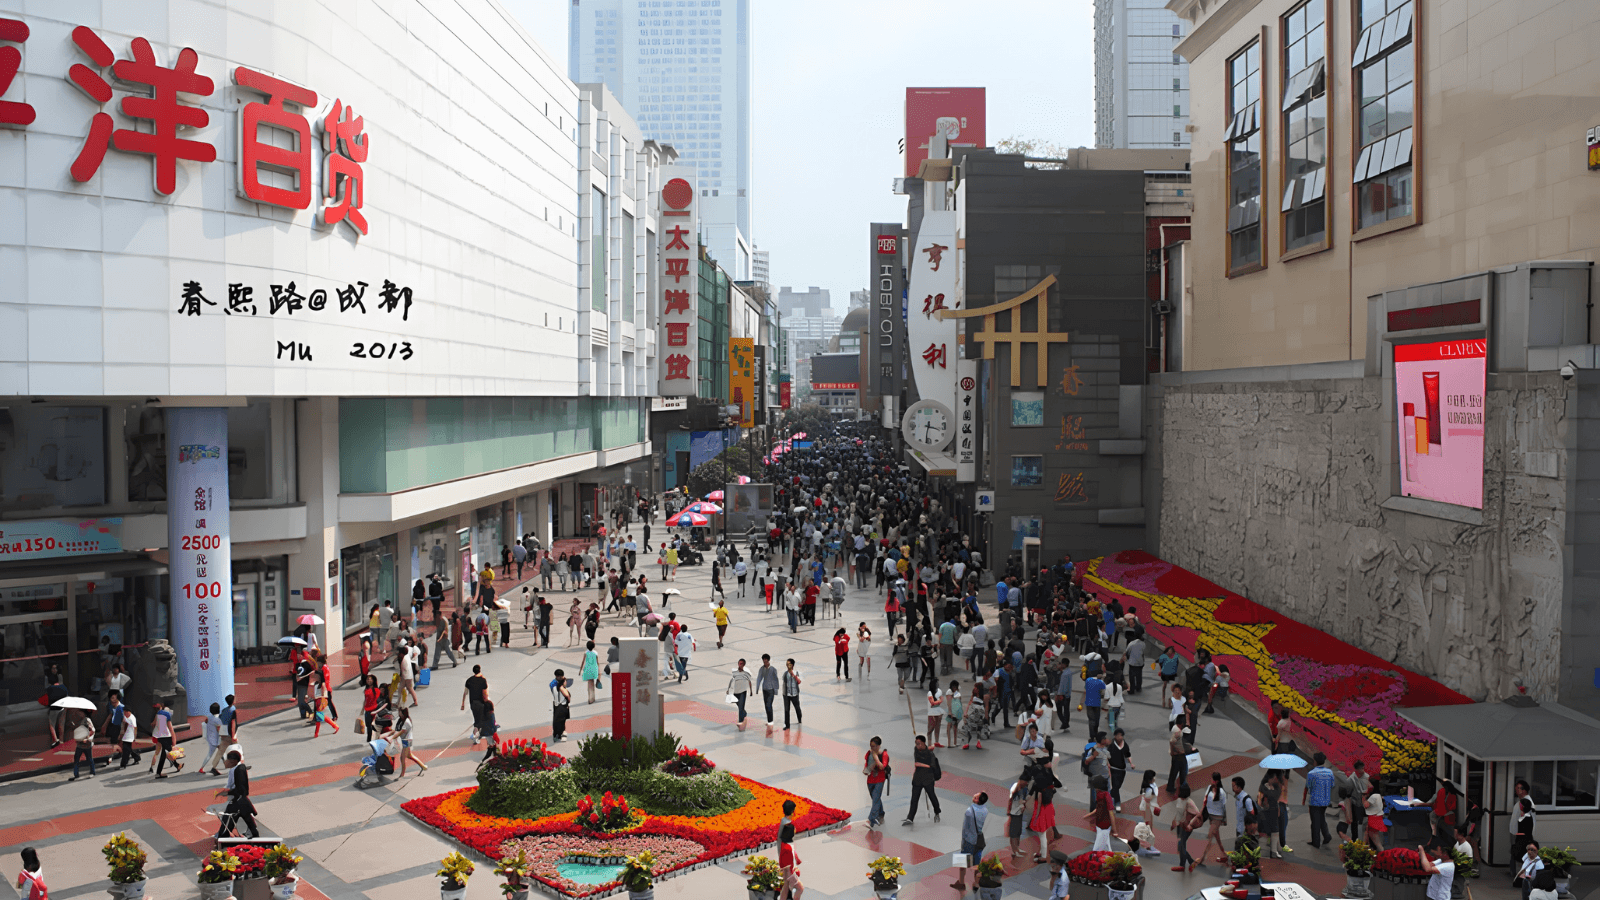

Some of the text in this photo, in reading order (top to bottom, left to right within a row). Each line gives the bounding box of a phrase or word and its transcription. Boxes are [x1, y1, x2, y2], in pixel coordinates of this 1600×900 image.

[664, 224, 691, 381] 太平洋百货
[24, 537, 56, 552] 150
[181, 535, 221, 551] 2500
[182, 581, 222, 599] 100
